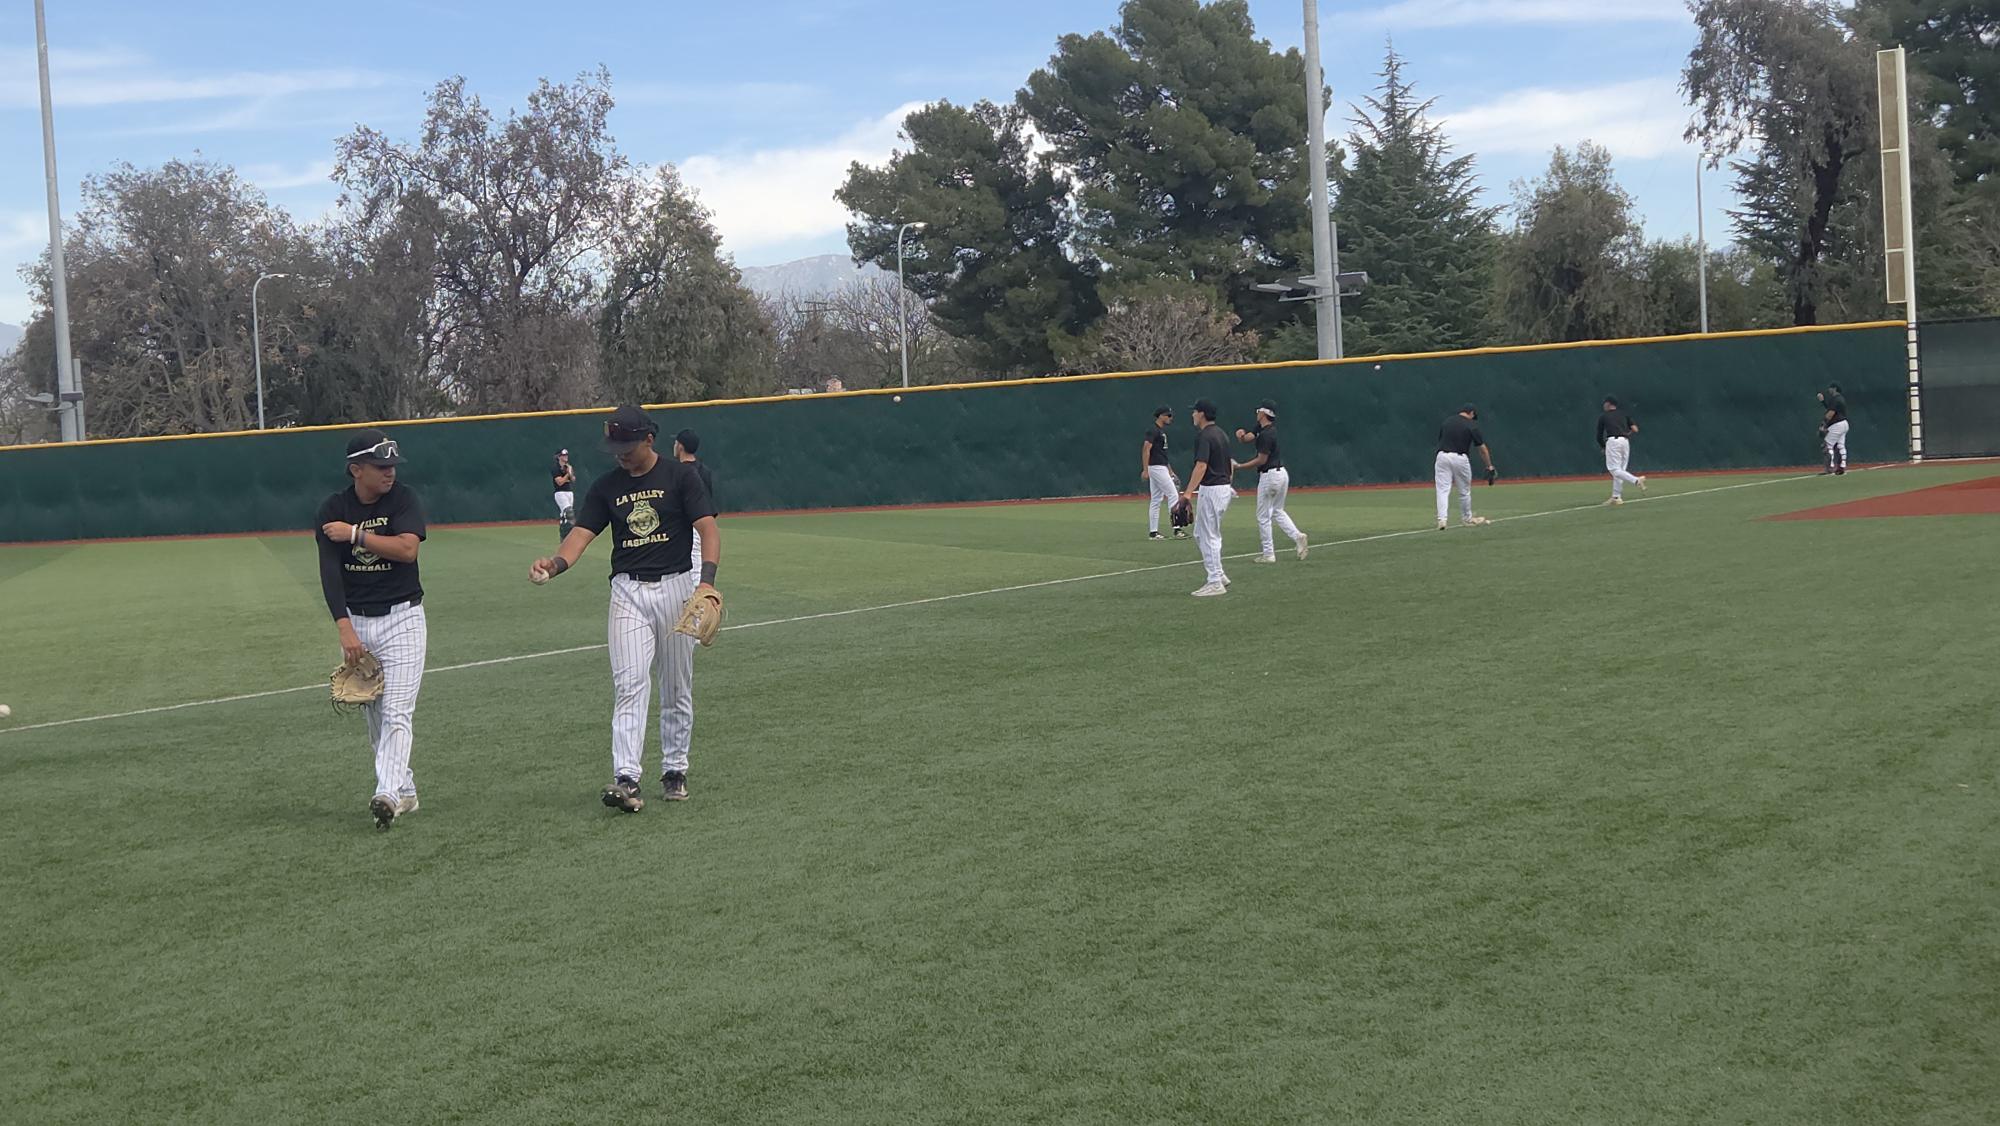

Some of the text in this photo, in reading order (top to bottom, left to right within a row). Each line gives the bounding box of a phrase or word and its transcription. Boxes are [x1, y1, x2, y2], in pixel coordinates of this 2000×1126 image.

[616, 489, 665, 506] LA VALLEY
[622, 533, 669, 548] BASEBALL
[344, 563, 392, 571] BASEBALL
